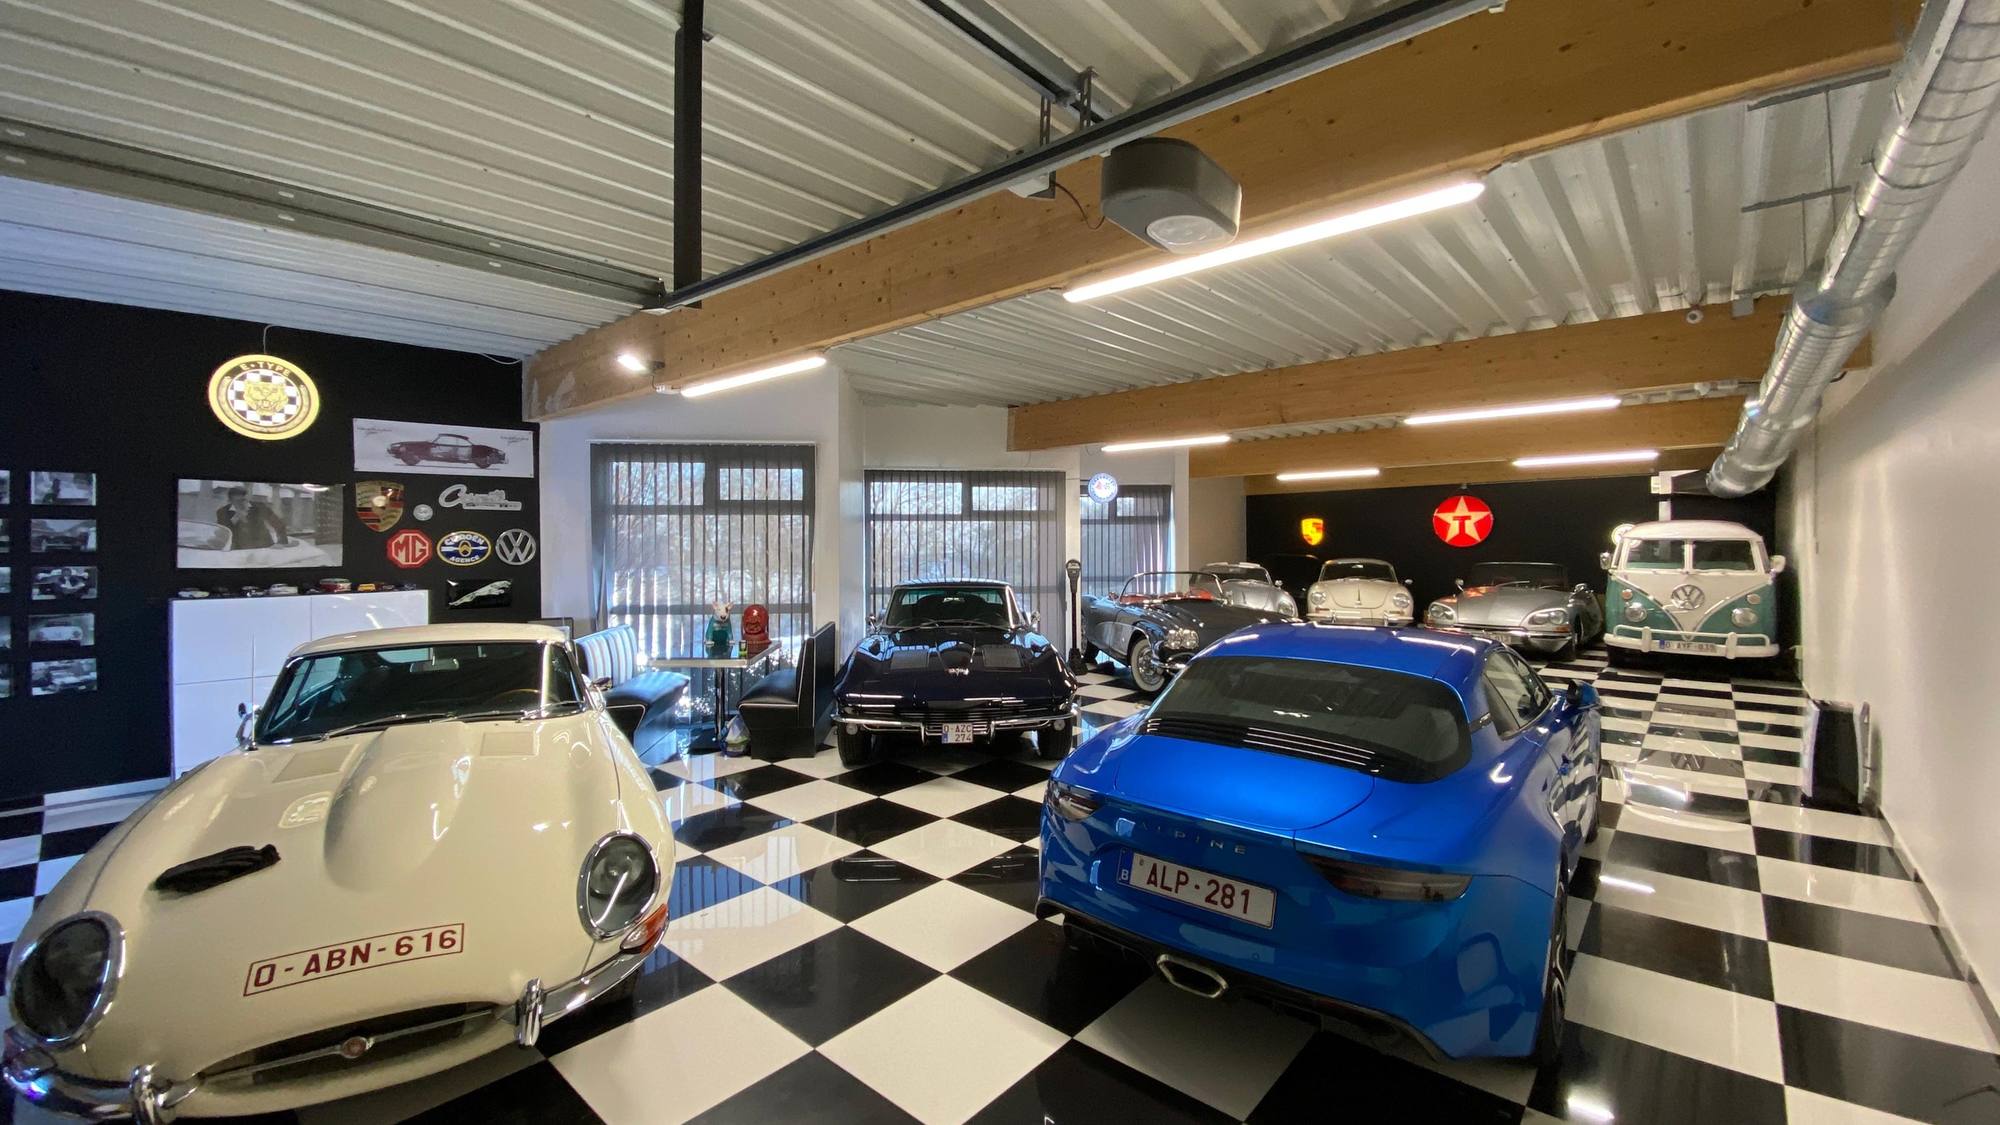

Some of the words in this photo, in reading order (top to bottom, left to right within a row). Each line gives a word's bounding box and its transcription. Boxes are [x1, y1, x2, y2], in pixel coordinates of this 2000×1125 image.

[1452, 515, 1472, 535] T
[392, 533, 429, 565] MG
[1120, 868, 1129, 881] B
